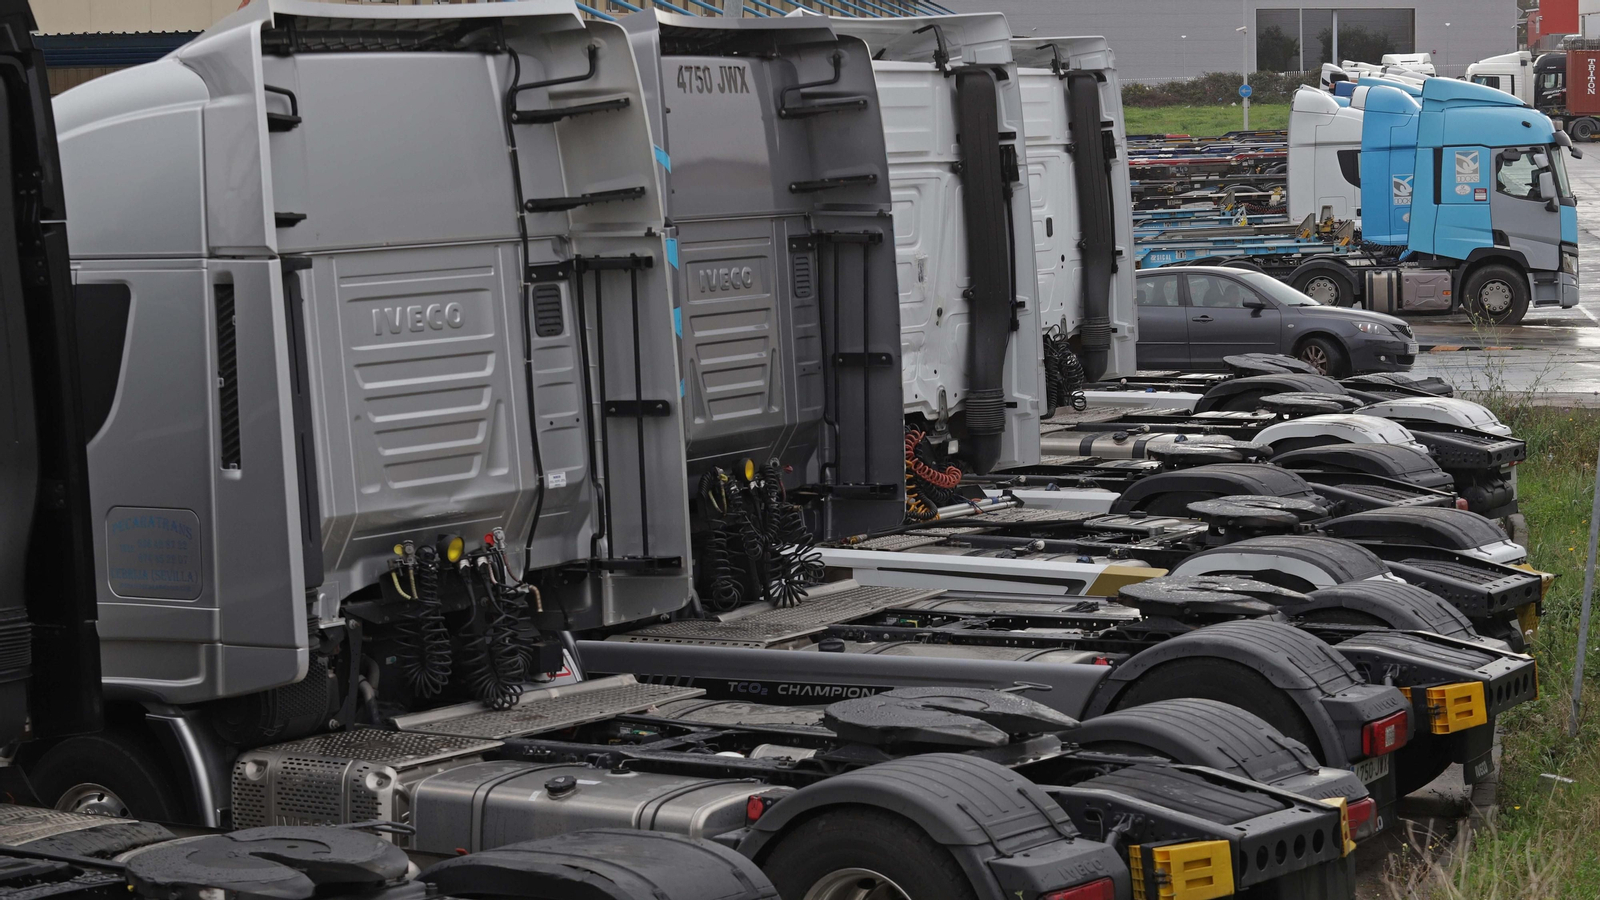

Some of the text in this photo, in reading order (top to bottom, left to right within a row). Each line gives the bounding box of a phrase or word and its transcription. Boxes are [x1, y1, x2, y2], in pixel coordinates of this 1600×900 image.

[677, 65, 750, 94] 4750 JWX
[1587, 58, 1596, 95] TRITON
[699, 266, 753, 293] IVECO
[372, 302, 465, 336] IVECO
[777, 684, 875, 698] CHAMPION
[1057, 859, 1103, 881] IVECO
